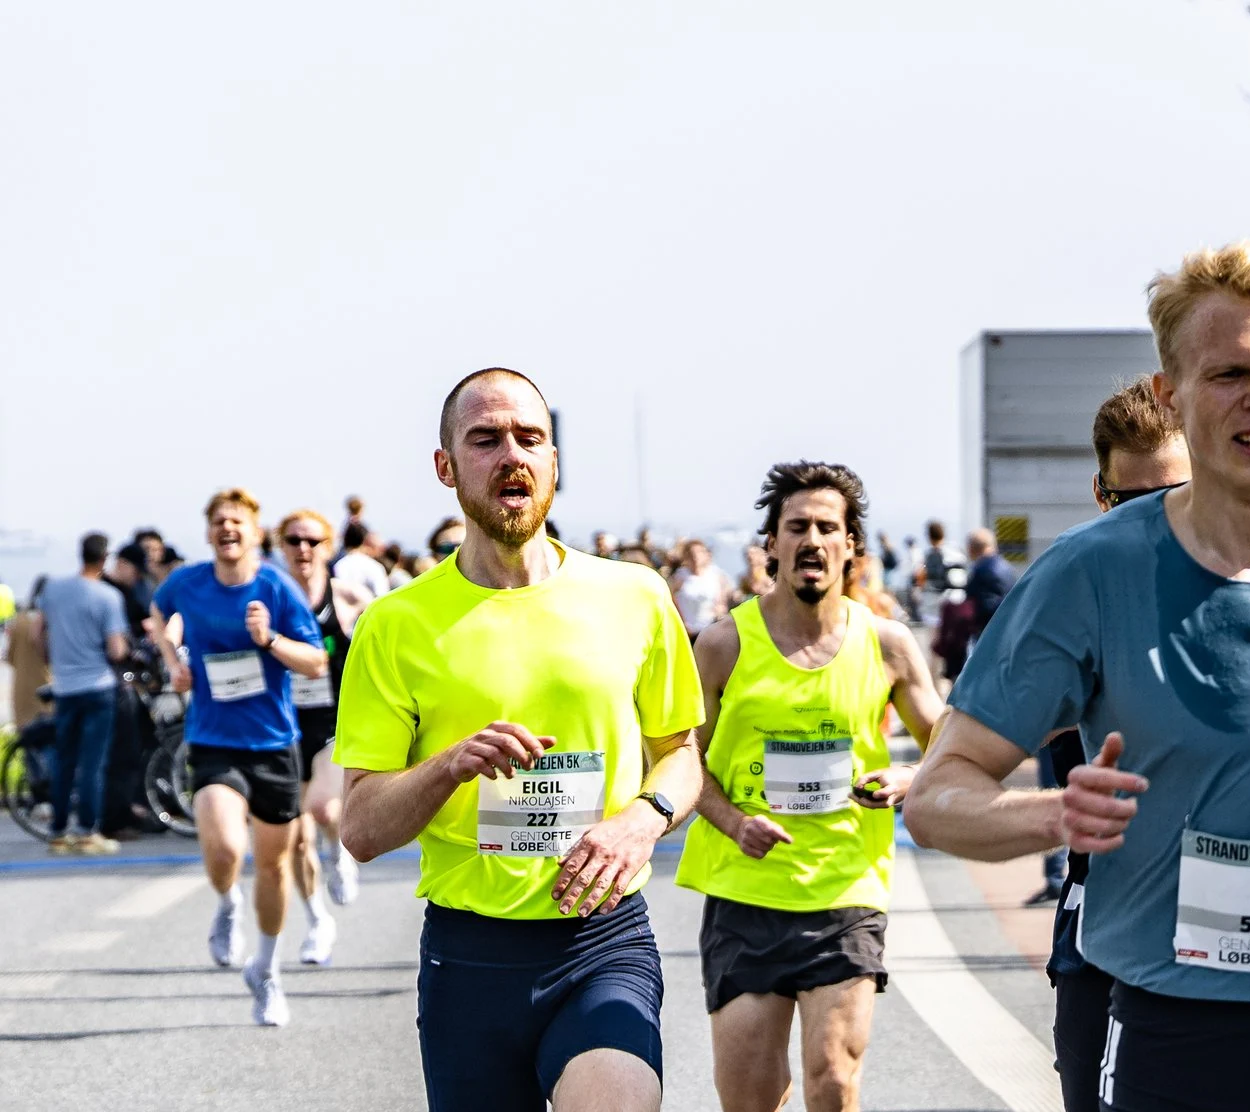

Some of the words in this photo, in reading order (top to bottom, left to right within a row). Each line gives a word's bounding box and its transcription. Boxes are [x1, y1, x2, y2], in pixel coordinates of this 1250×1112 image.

[770, 741, 824, 753] STRANDVEJEN
[826, 740, 836, 751] 5K
[566, 754, 580, 769] 5K
[522, 781, 564, 794] EIGIL
[797, 781, 820, 792] 553
[508, 795, 575, 808] NIKOLAJSEN
[526, 812, 559, 827] 227
[510, 830, 572, 842] GENTOFTE
